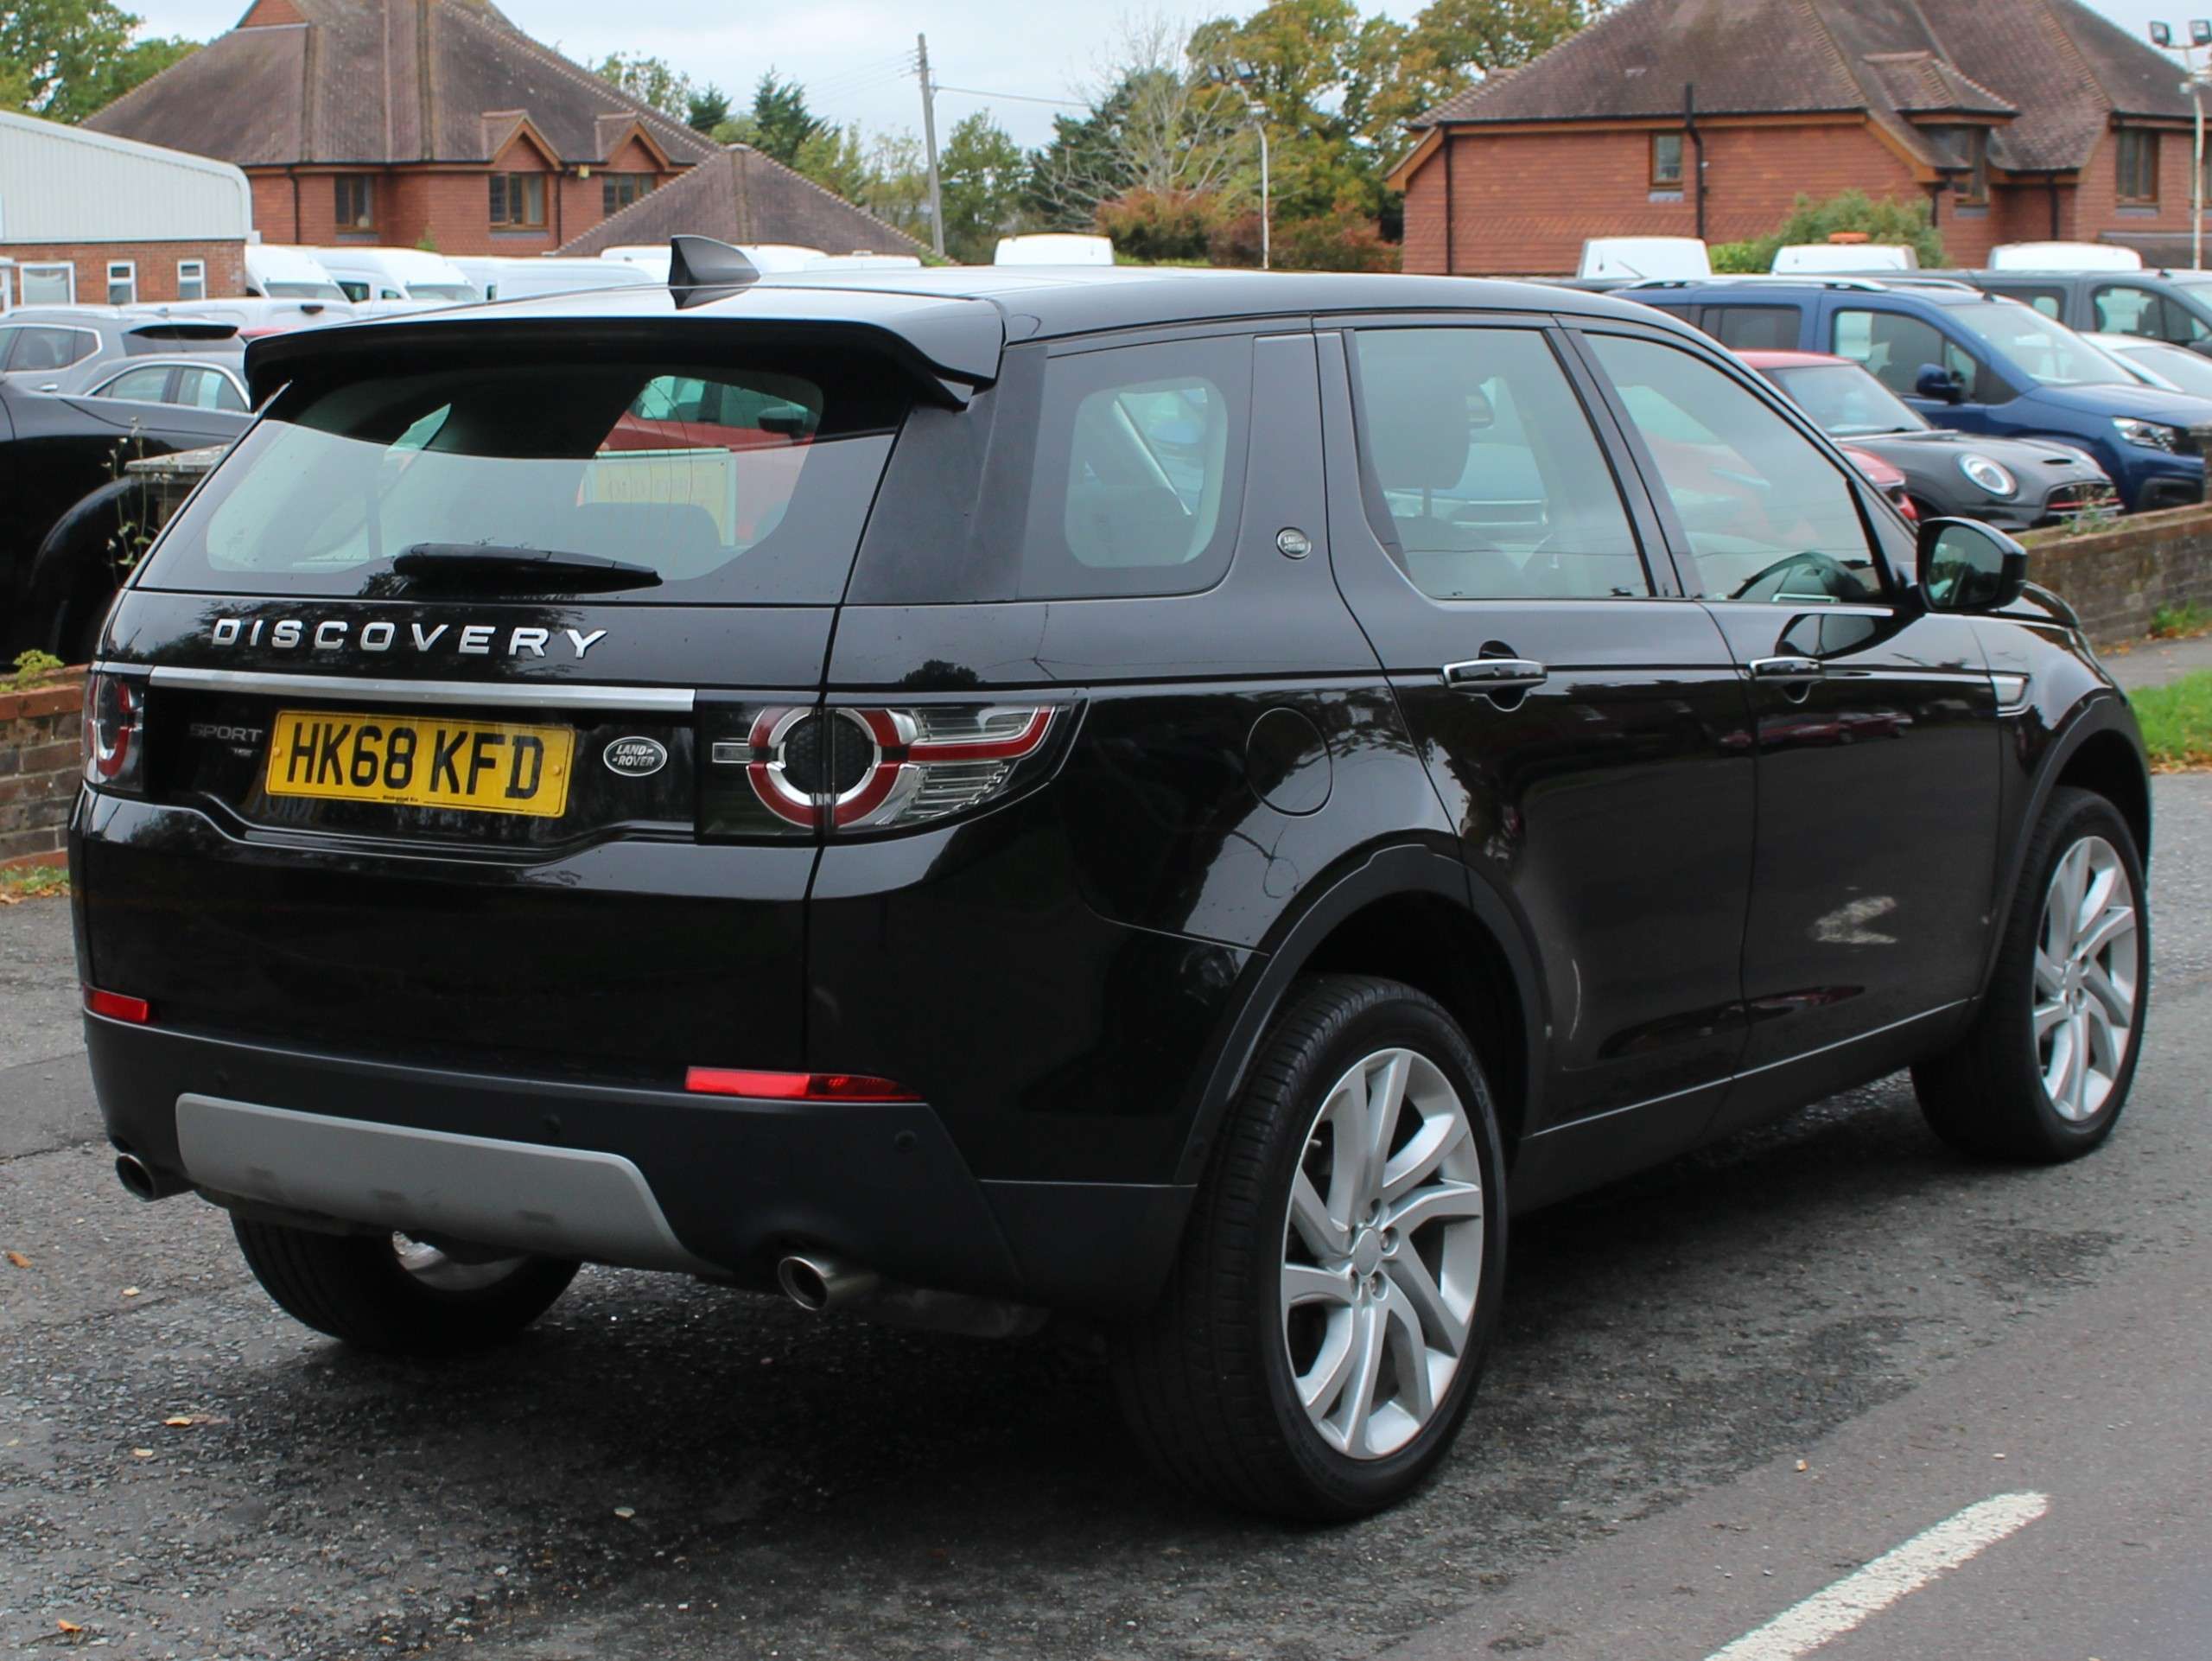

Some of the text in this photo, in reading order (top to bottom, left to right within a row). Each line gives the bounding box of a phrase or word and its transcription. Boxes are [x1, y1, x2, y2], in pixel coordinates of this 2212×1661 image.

[212, 618, 607, 659] DISCOVERY
[189, 723, 263, 742] SPORT
[615, 744, 647, 755] LAND
[286, 722, 545, 808] HK68 KFD
[617, 754, 655, 767] ROVER
